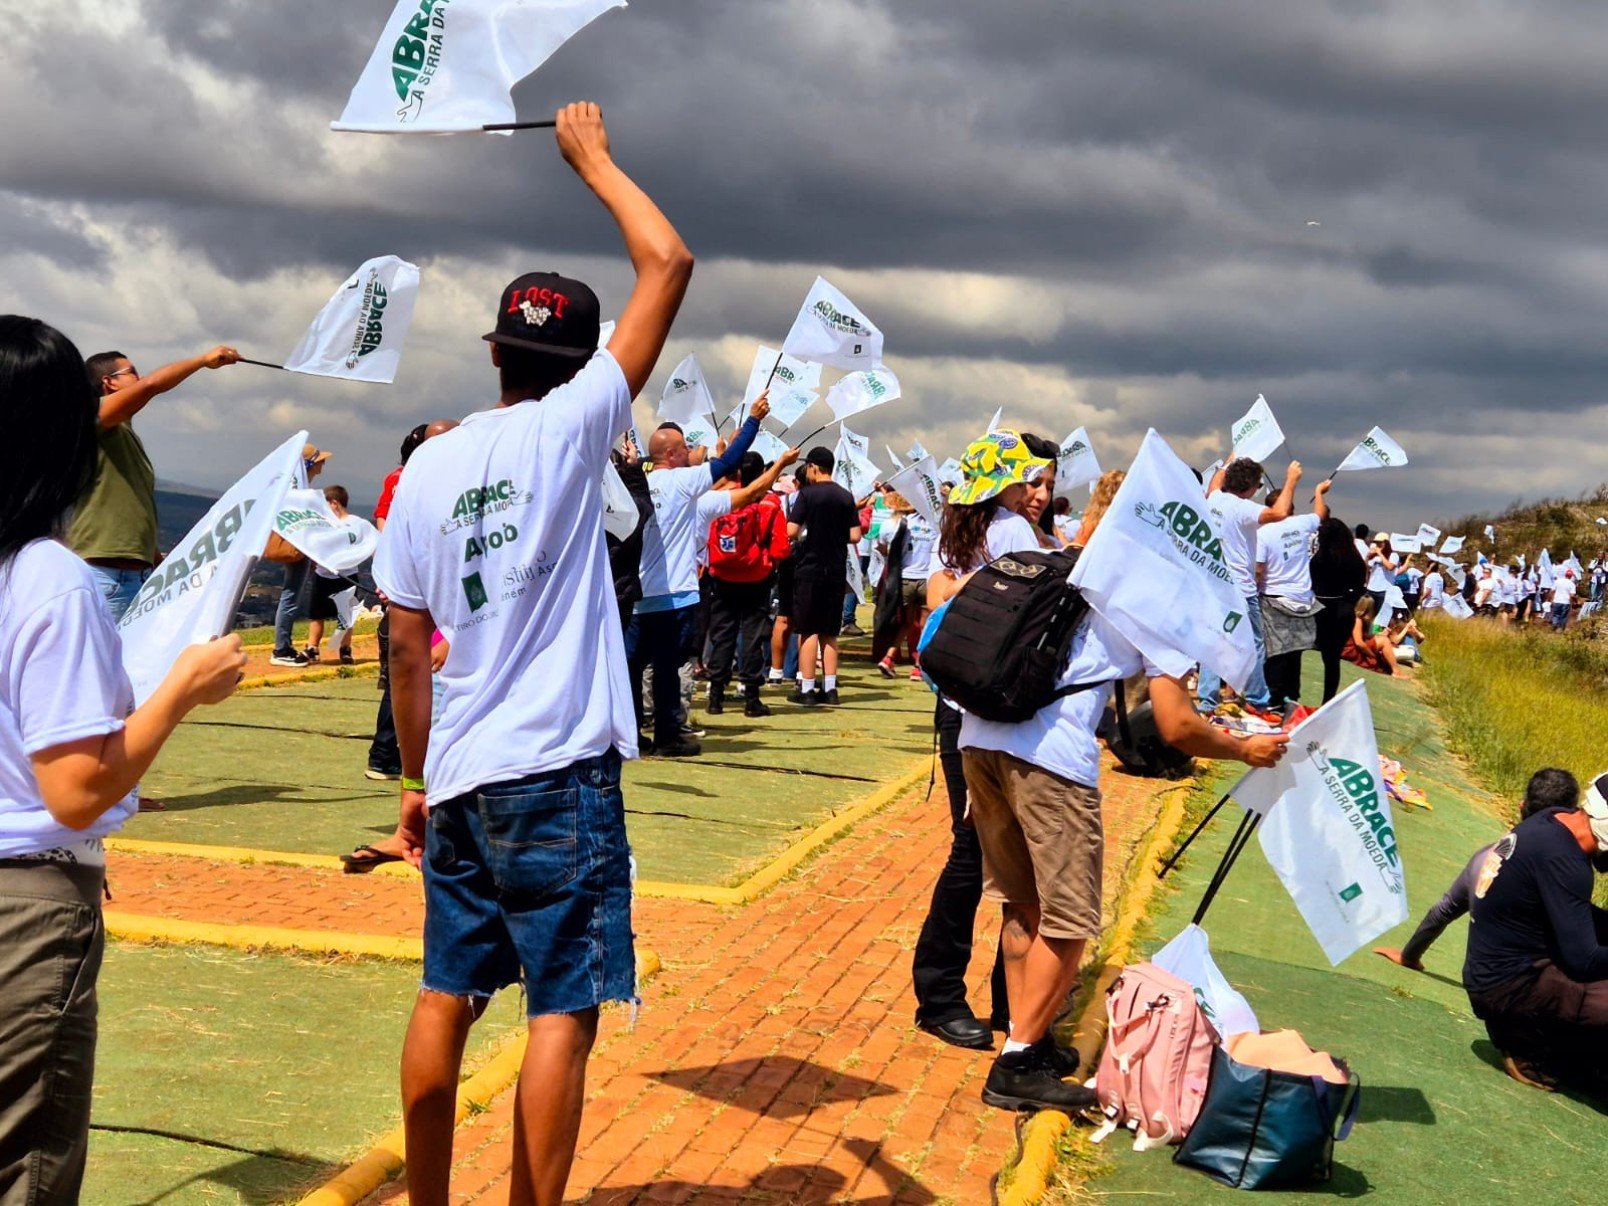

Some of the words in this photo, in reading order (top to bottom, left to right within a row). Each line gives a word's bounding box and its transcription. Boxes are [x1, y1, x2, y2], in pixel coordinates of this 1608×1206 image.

[411, 90, 424, 101] A
[418, 35, 444, 86] SERRA
[432, 7, 445, 29] DA
[1158, 501, 1227, 567] ABRA
[1190, 550, 1207, 567] DA
[1319, 766, 1330, 776] A
[1325, 775, 1354, 814] SERRA
[1349, 812, 1365, 831] DA
[1359, 830, 1389, 871] MOEDA
[1328, 758, 1398, 868] ABRACE
